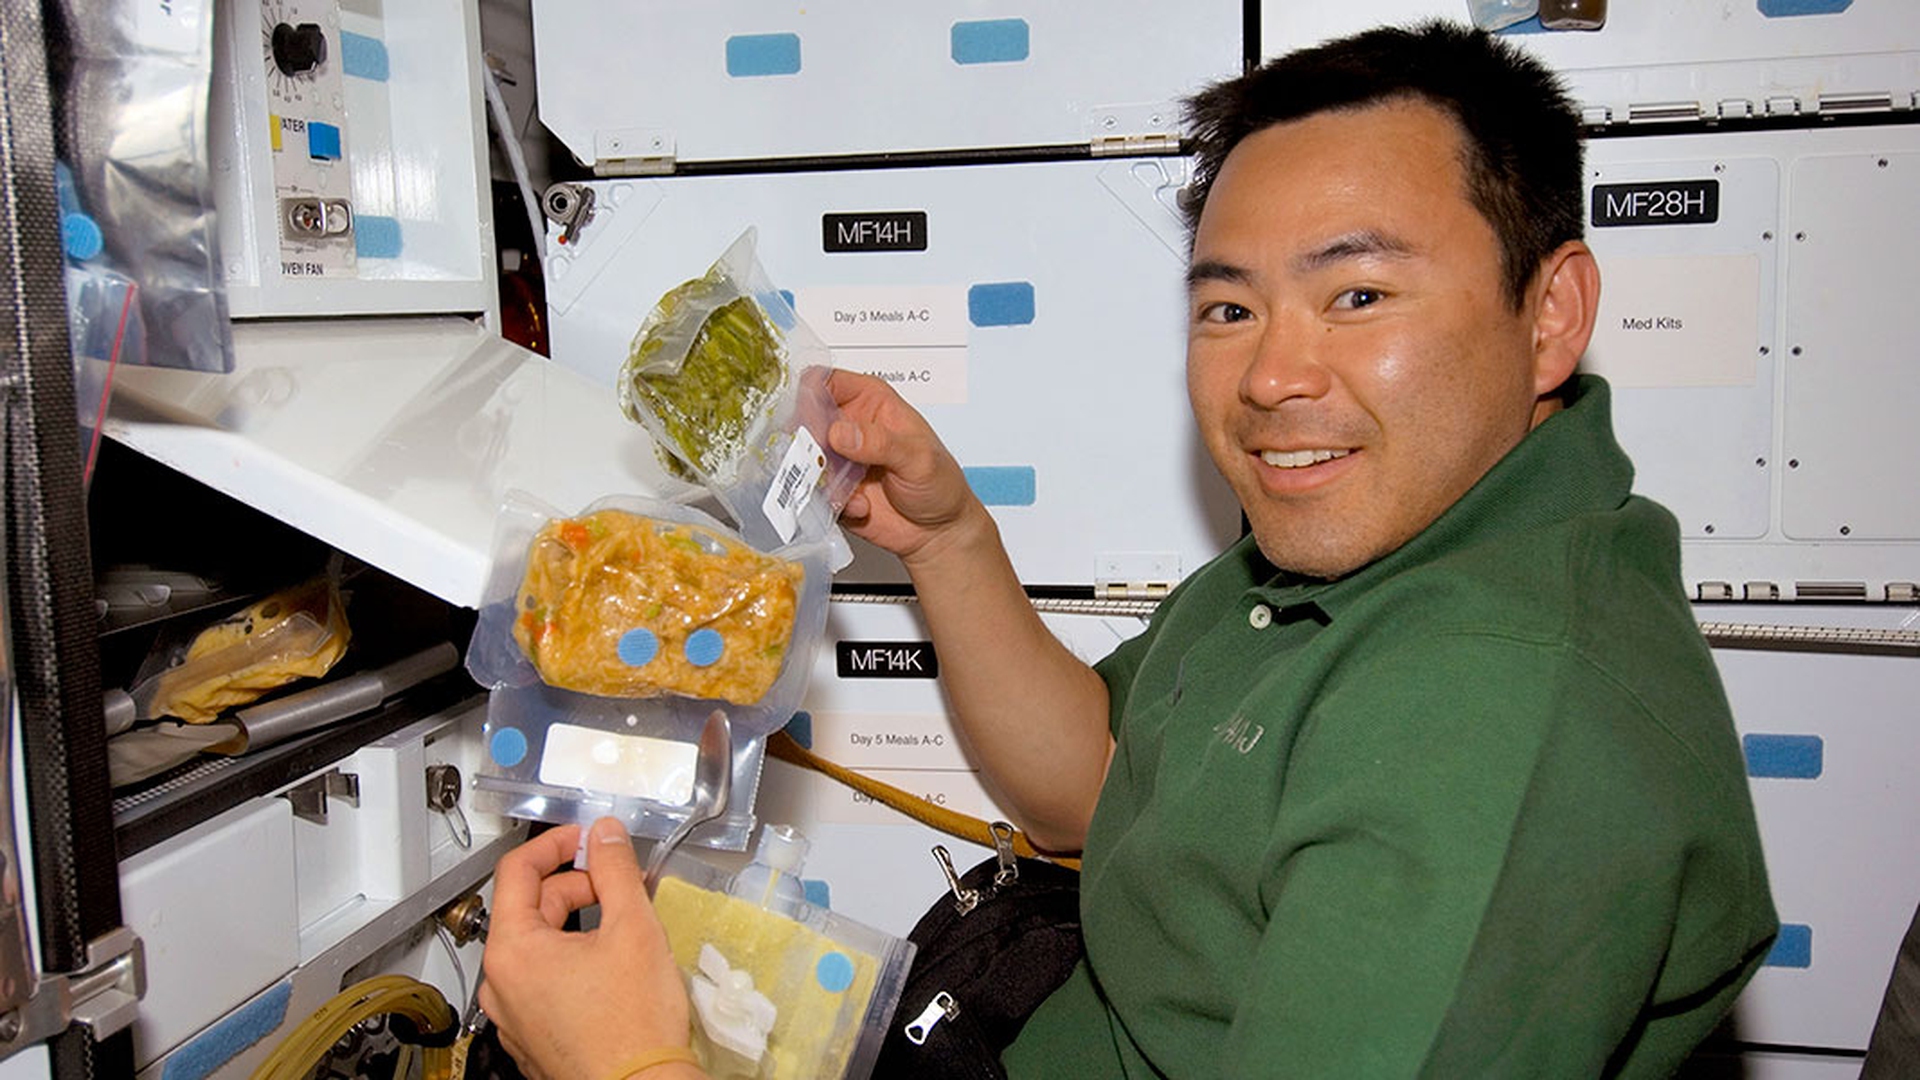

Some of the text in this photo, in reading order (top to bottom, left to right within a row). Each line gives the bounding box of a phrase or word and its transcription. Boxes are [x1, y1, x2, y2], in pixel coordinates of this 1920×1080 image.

[280, 118, 305, 133] ATER
[1606, 190, 1705, 217] MF28H
[837, 220, 912, 244] MF14H
[305, 263, 323, 275] FAN
[834, 309, 930, 324] Day 3 Meals A-C
[1622, 316, 1683, 330] Med Kits
[871, 370, 931, 382] eals A-C
[850, 649, 923, 671] MF14K
[850, 733, 944, 747] Day 5 Meals A-C
[924, 793, 946, 805] A-C
